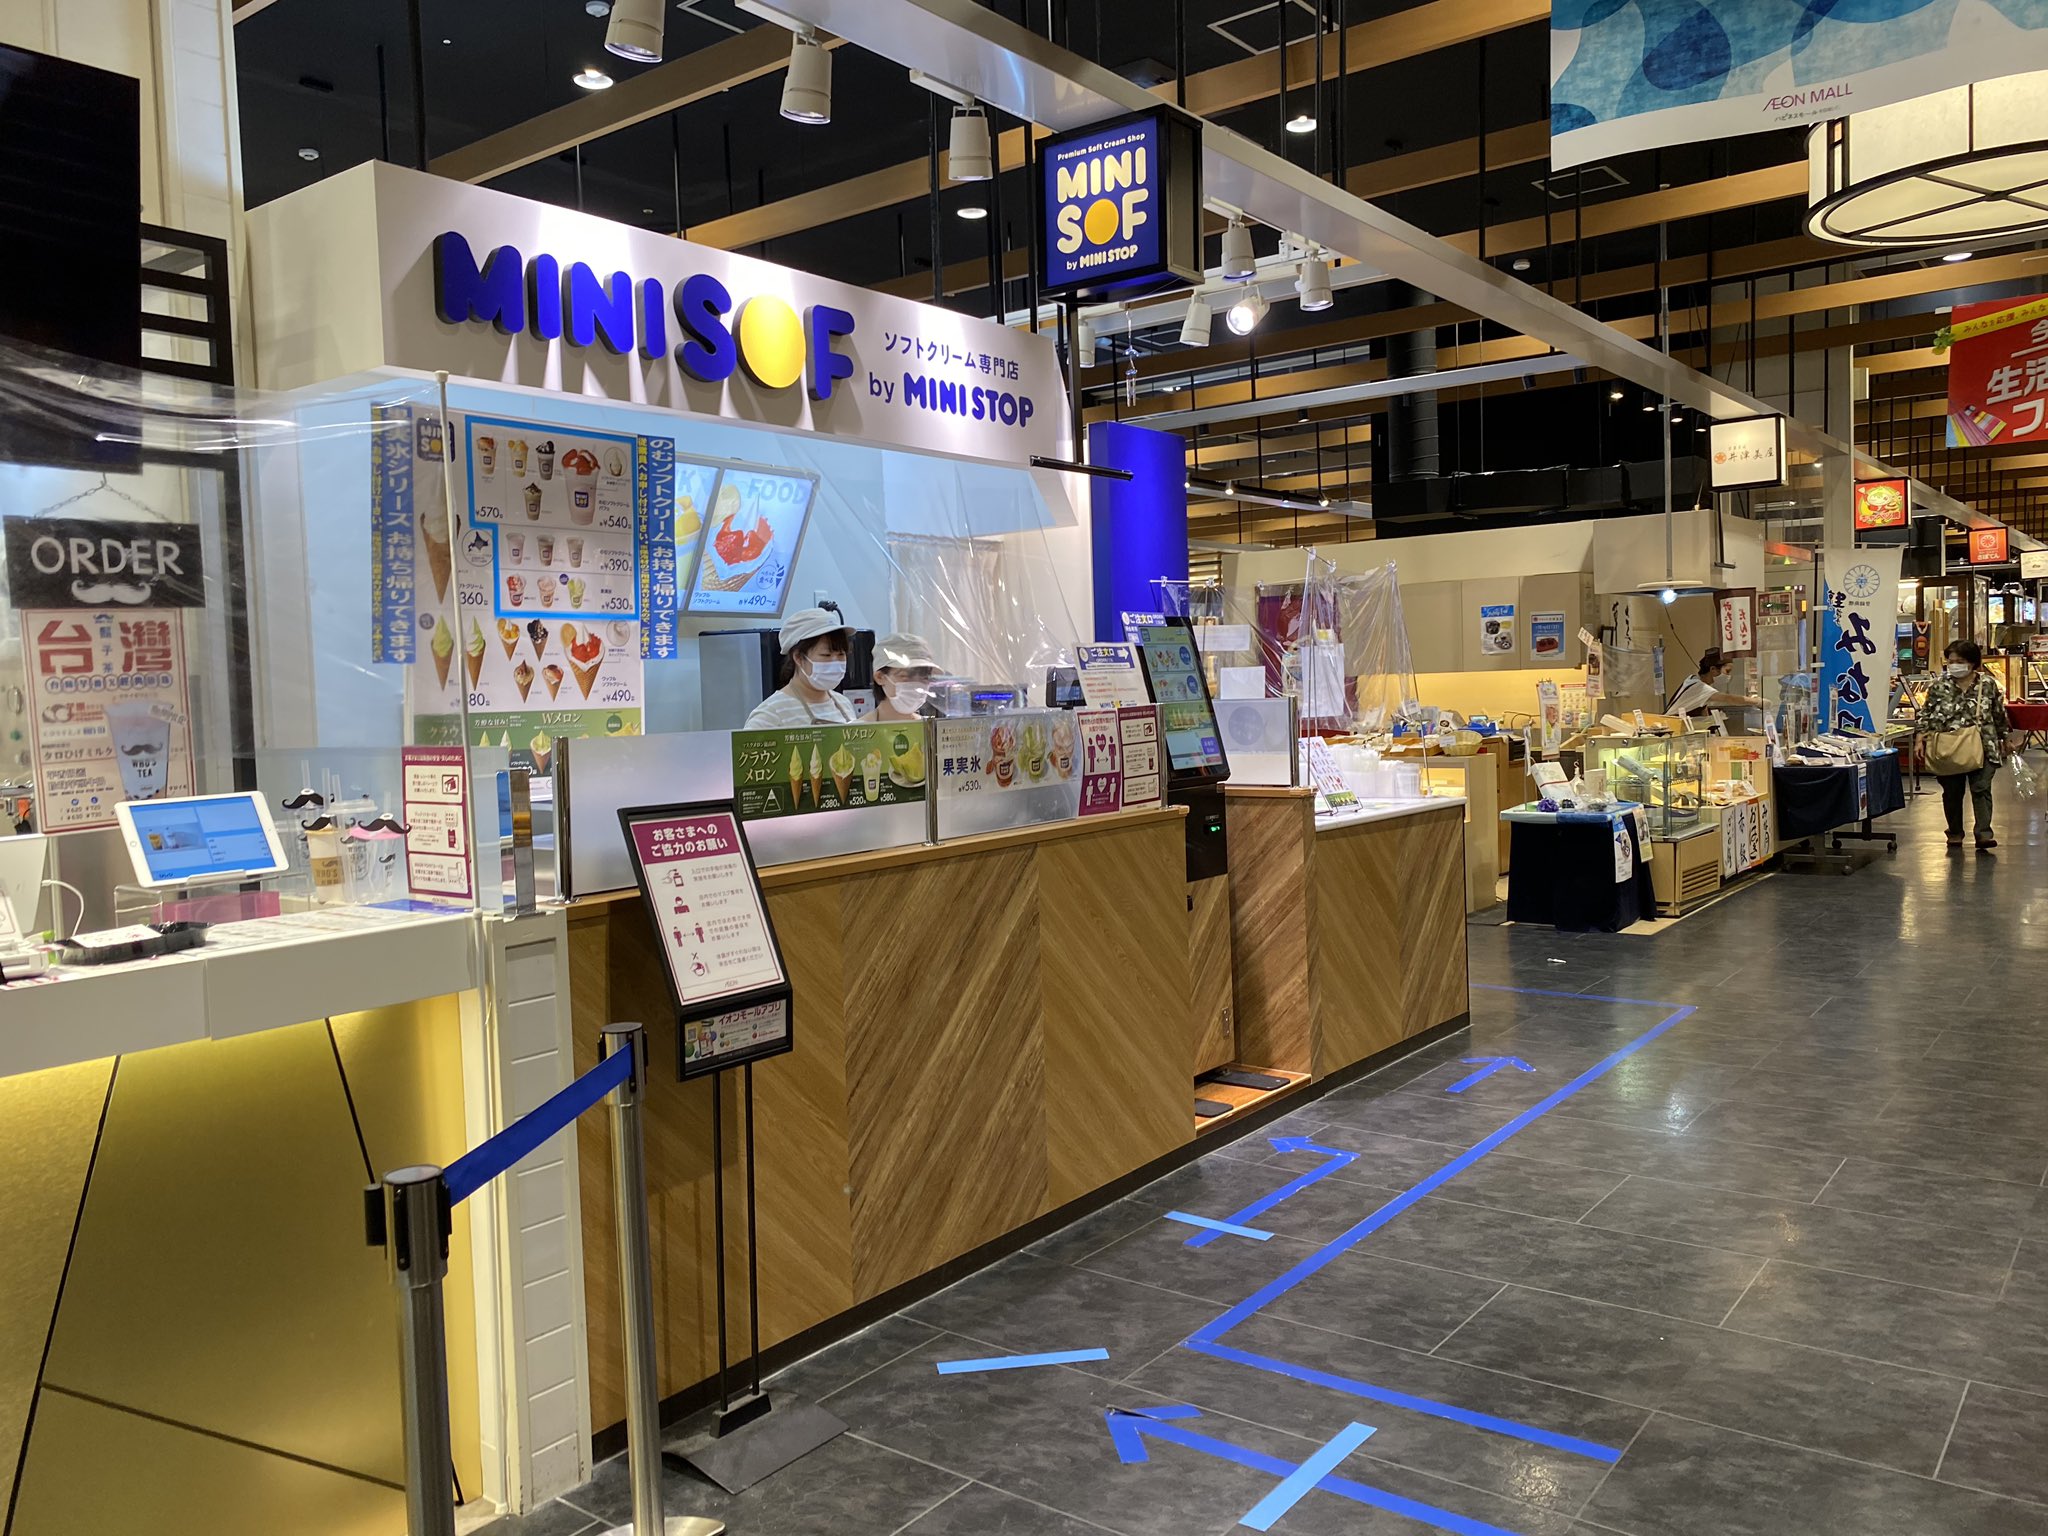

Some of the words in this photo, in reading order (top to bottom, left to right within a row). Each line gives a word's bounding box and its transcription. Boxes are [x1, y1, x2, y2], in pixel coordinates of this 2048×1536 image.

[1810, 82, 1854, 104] MALL
[1057, 148, 1087, 161] Premium
[1087, 143, 1103, 154] Soft
[1103, 138, 1127, 150] Cream
[1126, 132, 1146, 144] Shop
[1057, 146, 1147, 204] MINI
[1057, 188, 1149, 254] SOF
[1066, 260, 1078, 271] by
[884, 331, 1019, 381] ソフトクリーム専門店
[869, 371, 895, 404] by
[2012, 397, 2048, 438] フ
[649, 438, 674, 543] のむソフトクリーム
[747, 478, 805, 505] FOOD
[30, 536, 185, 576] ORDER
[652, 546, 676, 658] お持ち帰りできます
[1090, 647, 1115, 657] ご注文口
[542, 711, 583, 725] Wメロン
[841, 728, 877, 741] Wメロン
[738, 749, 782, 768] クラウン
[943, 755, 982, 776] 果実氷
[137, 768, 153, 778] TEA
[743, 768, 777, 784] メロン
[652, 823, 718, 841] お客さまへの
[651, 838, 728, 857] ご協力のお願い
[718, 1002, 782, 1026] イオンモールアプリ
